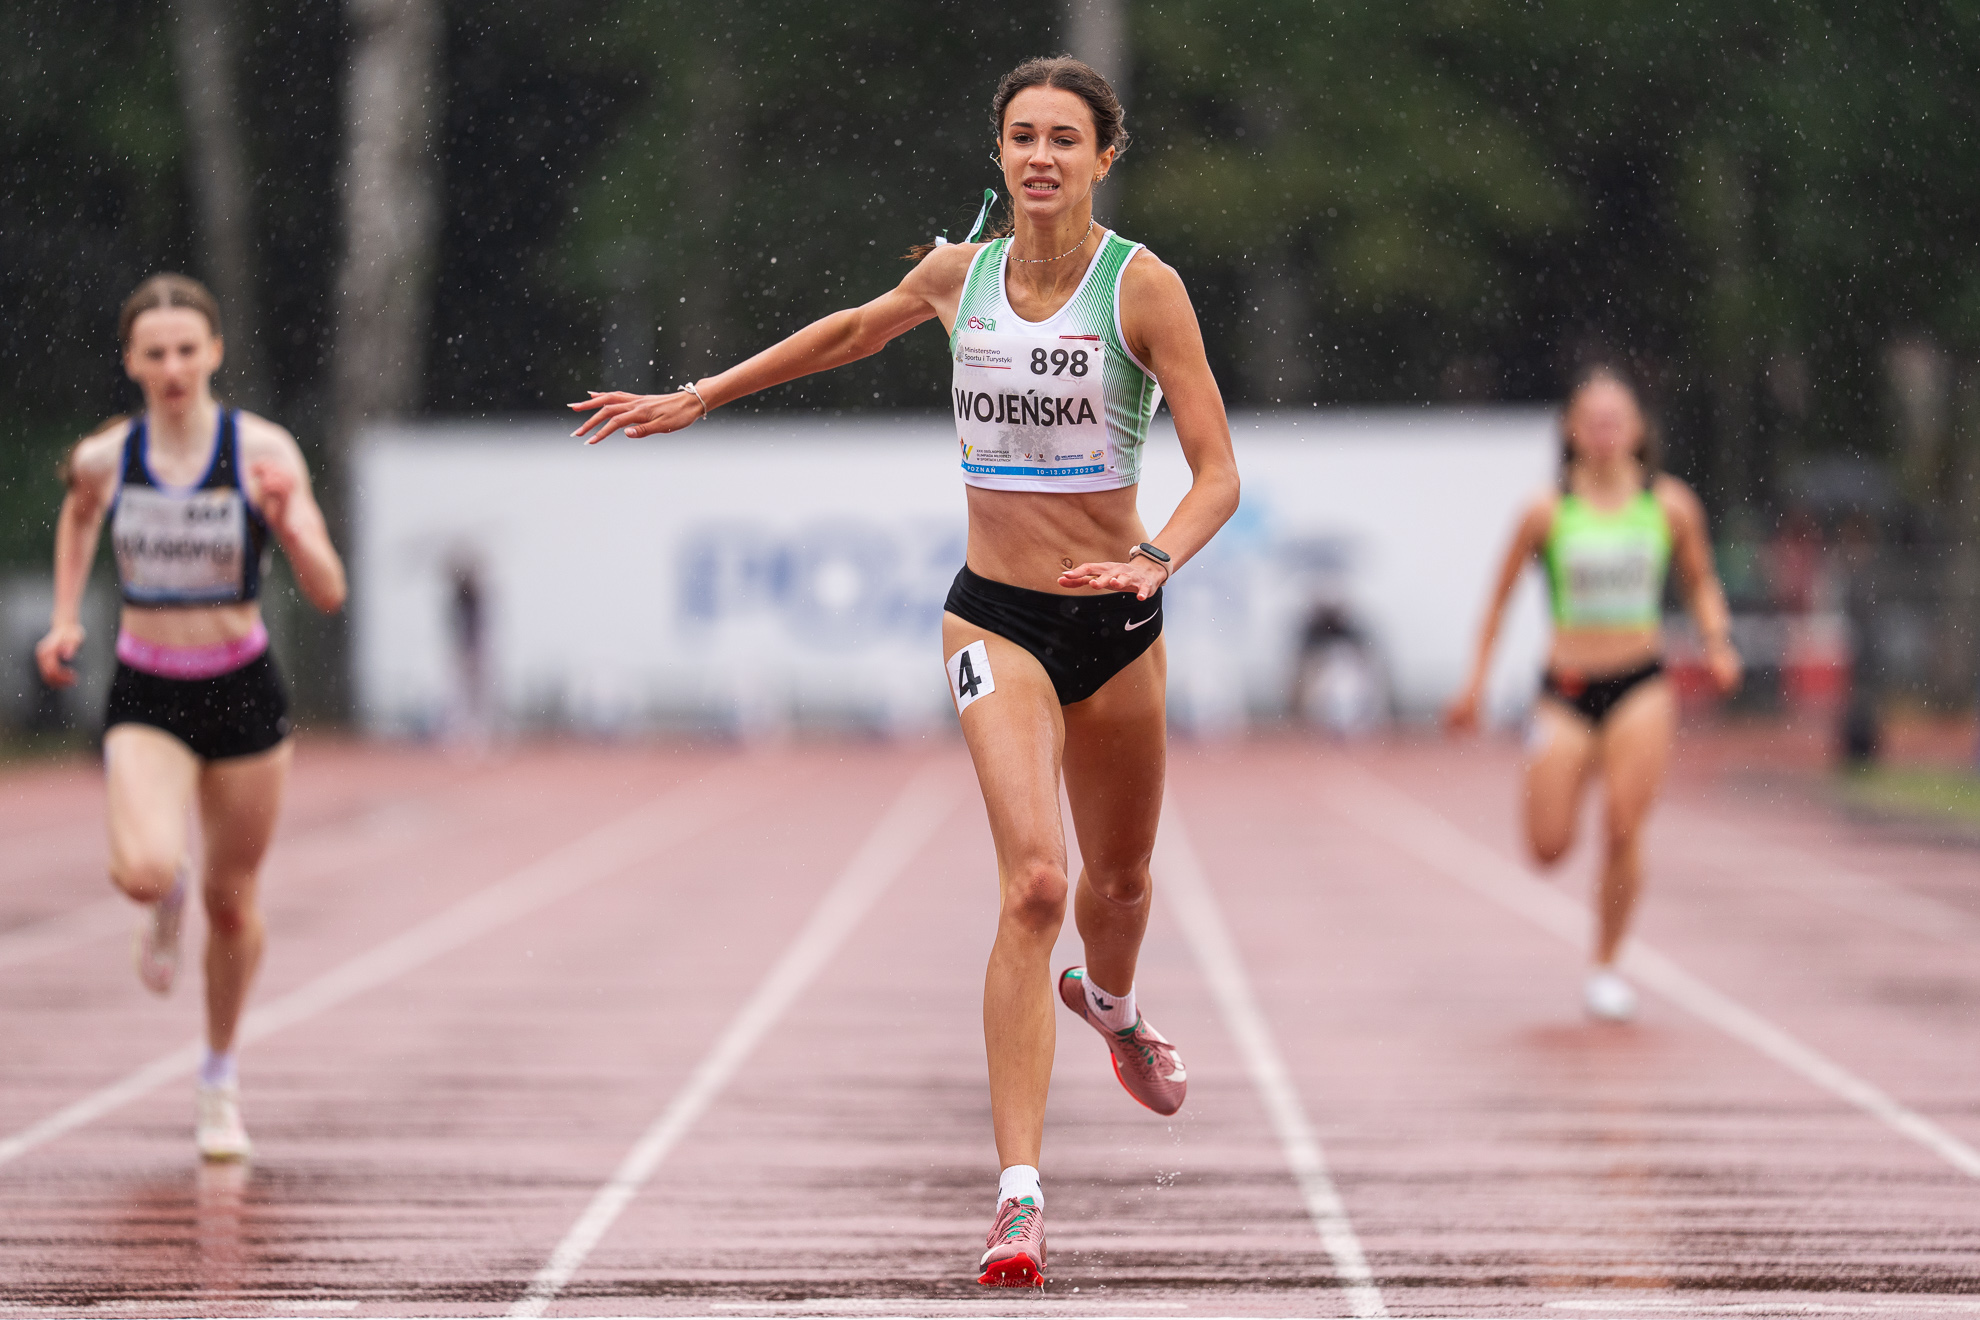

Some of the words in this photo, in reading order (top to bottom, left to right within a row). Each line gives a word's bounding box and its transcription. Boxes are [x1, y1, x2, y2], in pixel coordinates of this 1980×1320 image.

[965, 347, 1001, 355] Ministerstwo
[965, 354, 982, 362] Sportu
[986, 355, 1012, 364] Turystyki
[1030, 348, 1088, 377] 898
[955, 388, 1097, 426] WOJEŃSKA
[967, 465, 996, 473] POZNAŃ
[1036, 467, 1094, 475] 10-13.07.2025
[959, 650, 982, 698] 4
